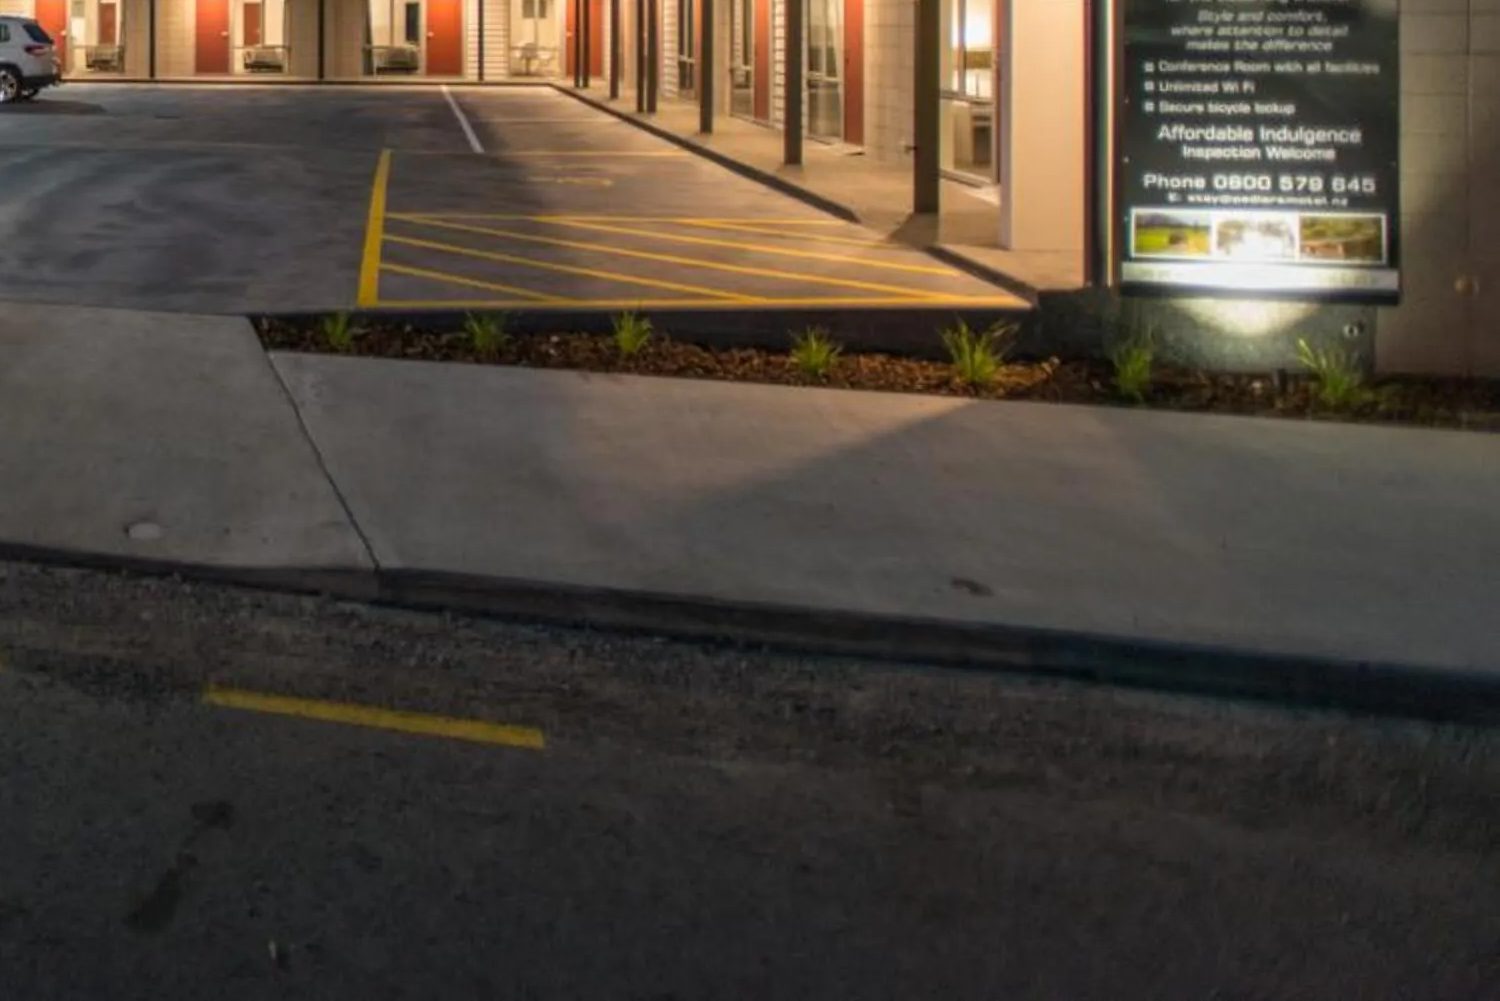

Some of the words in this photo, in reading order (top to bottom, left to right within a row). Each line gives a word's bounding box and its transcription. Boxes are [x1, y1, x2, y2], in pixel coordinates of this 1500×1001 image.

[1233, 60, 1272, 73] Room
[1158, 80, 1219, 93] Unlimited
[1158, 102, 1204, 114] Secure
[1157, 125, 1254, 143] Affordable
[1259, 127, 1362, 145] Indulgence
[1182, 145, 1261, 161] Inspection
[1265, 146, 1337, 161] Welcome
[1142, 173, 1206, 190] Phone
[1212, 174, 1273, 191] 0800
[1331, 176, 1377, 193] 645
